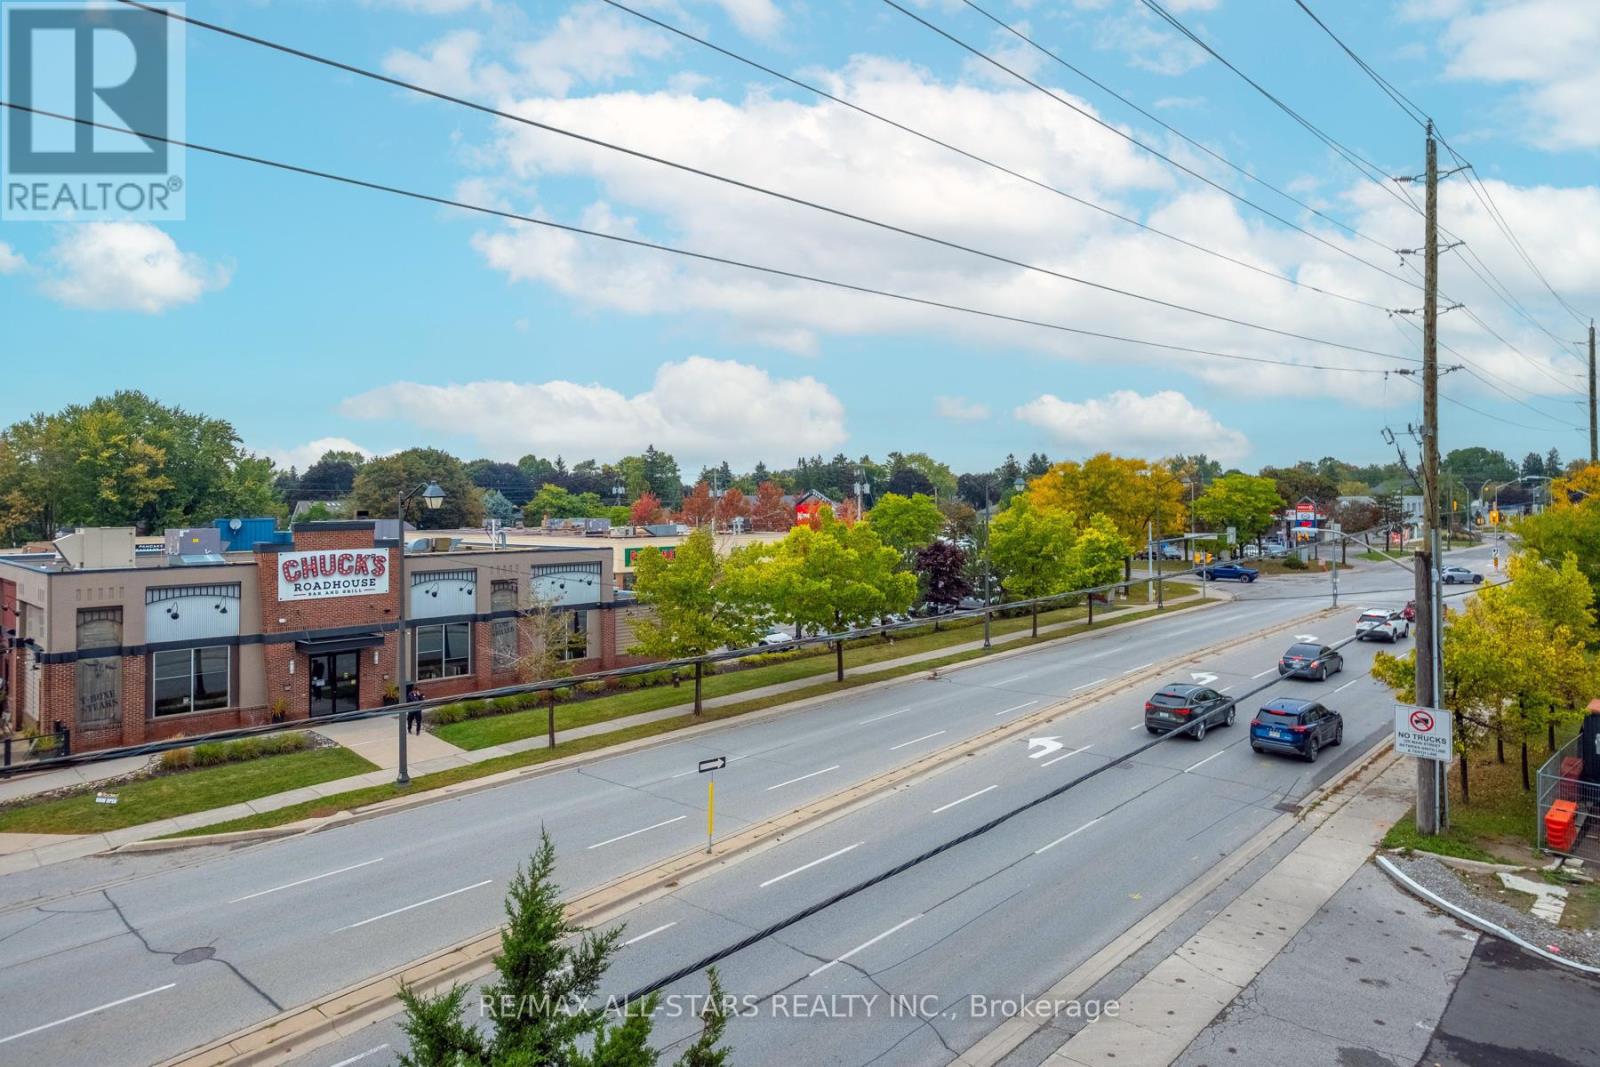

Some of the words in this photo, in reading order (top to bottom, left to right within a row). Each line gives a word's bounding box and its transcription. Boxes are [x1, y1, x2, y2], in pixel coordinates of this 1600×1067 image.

[282, 553, 387, 582] CHUCK'S
[294, 578, 376, 592] ROADHOUSE
[80, 699, 119, 713] STEAKS
[1398, 731, 1411, 739] NO
[1412, 733, 1447, 745] TRUCKS
